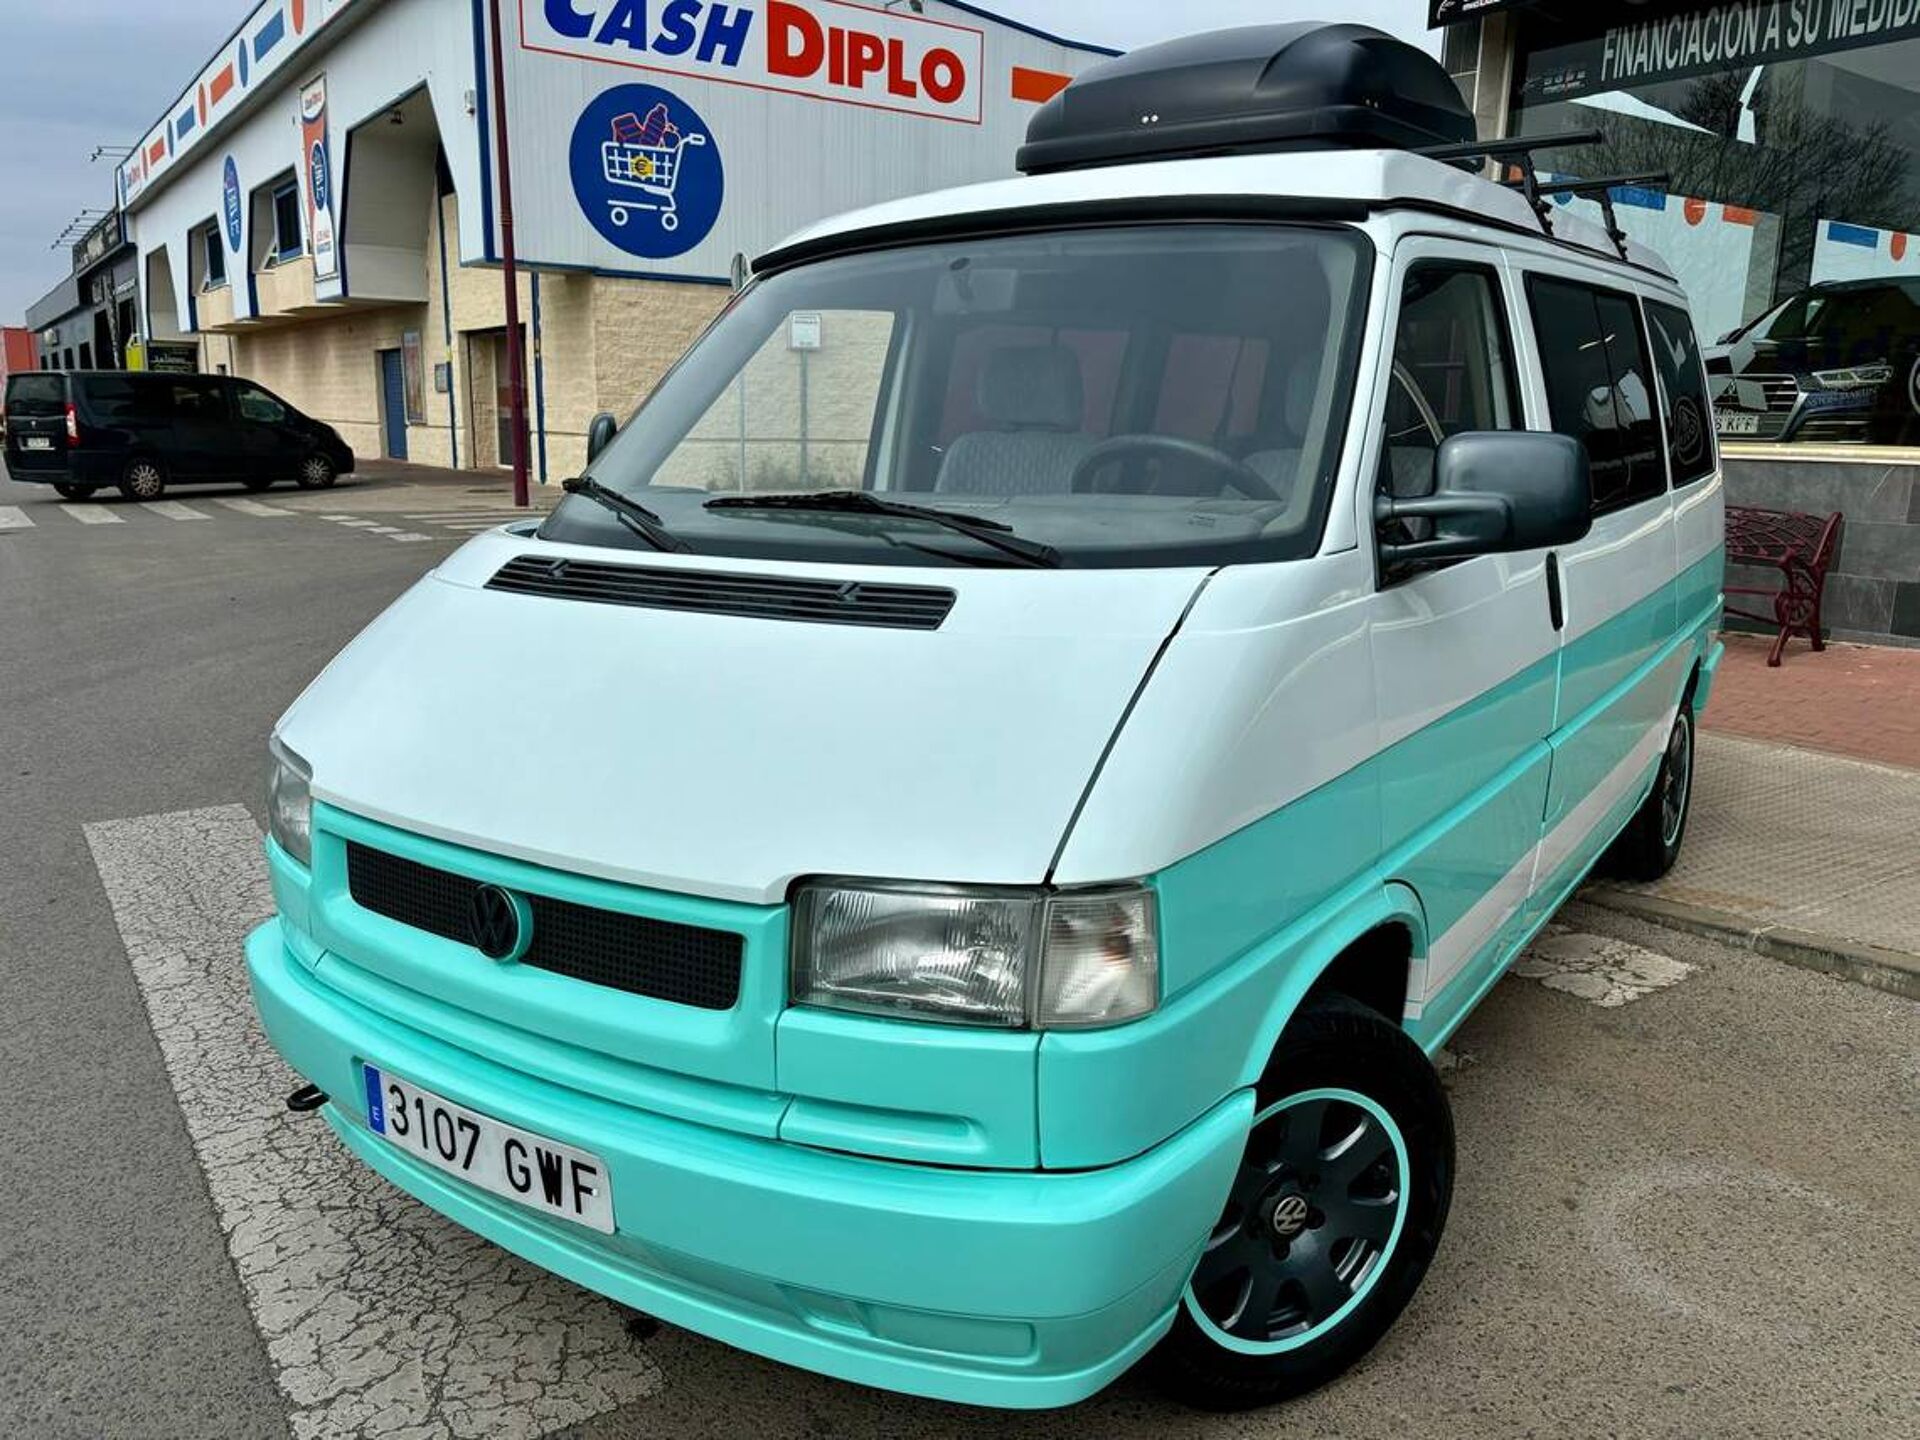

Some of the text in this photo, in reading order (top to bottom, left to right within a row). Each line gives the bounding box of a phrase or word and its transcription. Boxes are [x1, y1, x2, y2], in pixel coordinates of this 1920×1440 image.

[543, 0, 966, 104] CASH DIPLO
[1601, 1, 1763, 81] FINANCIACION
[1761, 0, 1781, 52] A
[1786, 0, 1823, 48] SU
[371, 1104, 381, 1121] E
[388, 1084, 598, 1214] 3107 GWF
